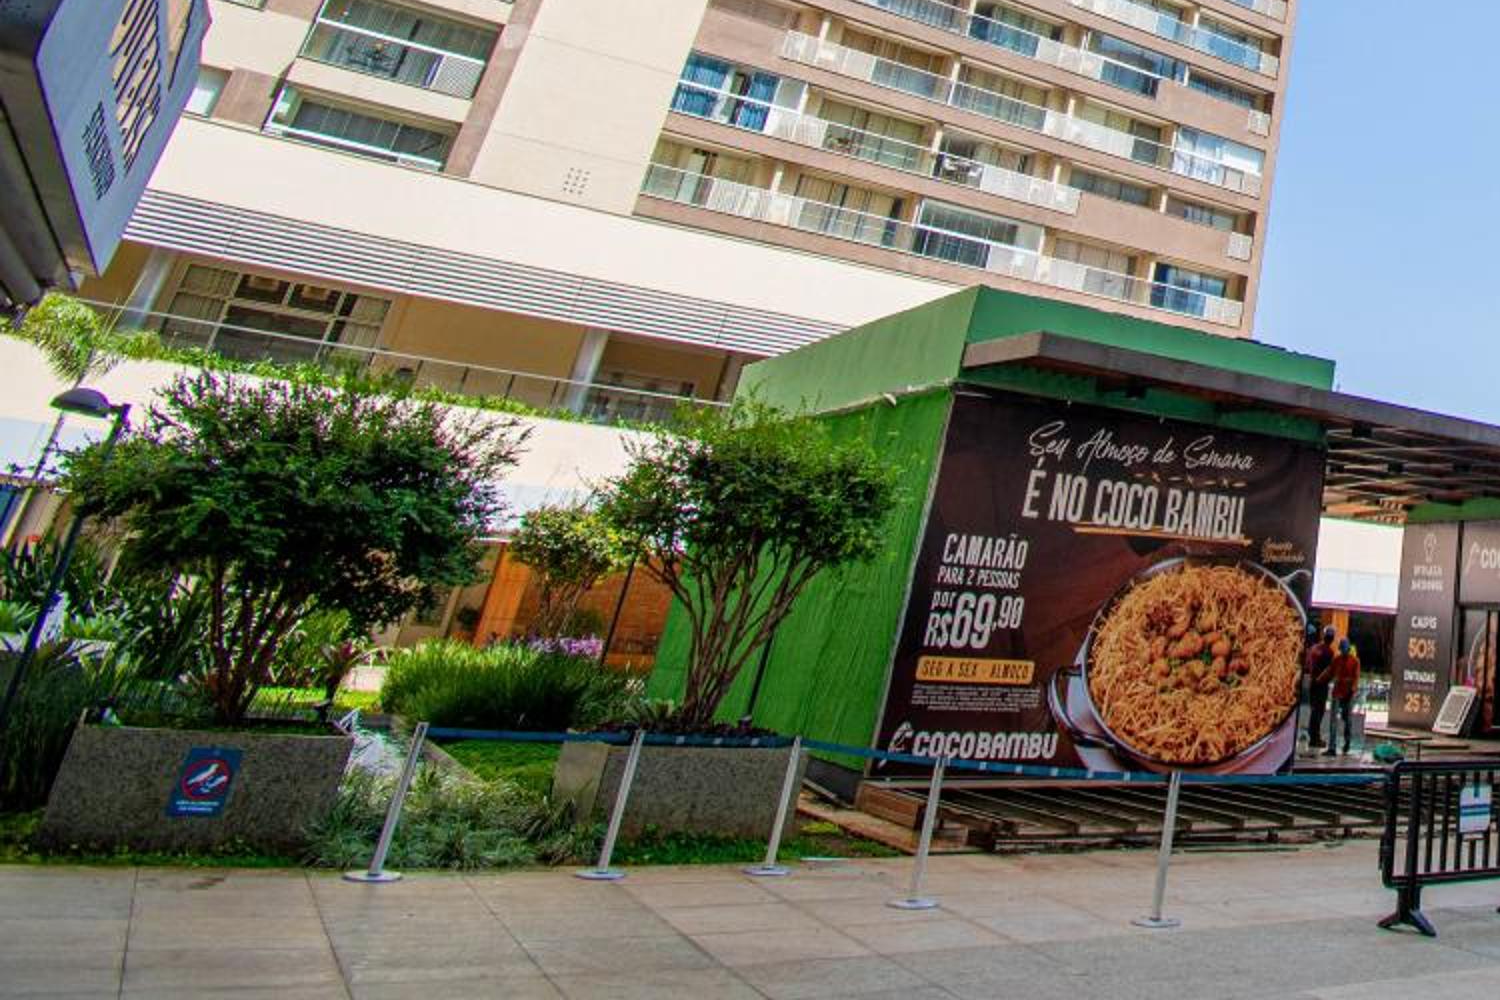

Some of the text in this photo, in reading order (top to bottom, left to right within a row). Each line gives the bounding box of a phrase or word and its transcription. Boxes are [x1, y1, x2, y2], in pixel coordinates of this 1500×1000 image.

[1029, 419, 1254, 475] Seu Almoço de Semana
[1022, 457, 1047, 518] É
[1048, 472, 1088, 523] NO
[1093, 479, 1158, 531] COCO
[942, 533, 1029, 569] CAMARÃO
[938, 566, 1021, 589] PARA 2 PESSOAS
[931, 591, 957, 610] por
[911, 730, 1058, 760] COCOBAMBU
